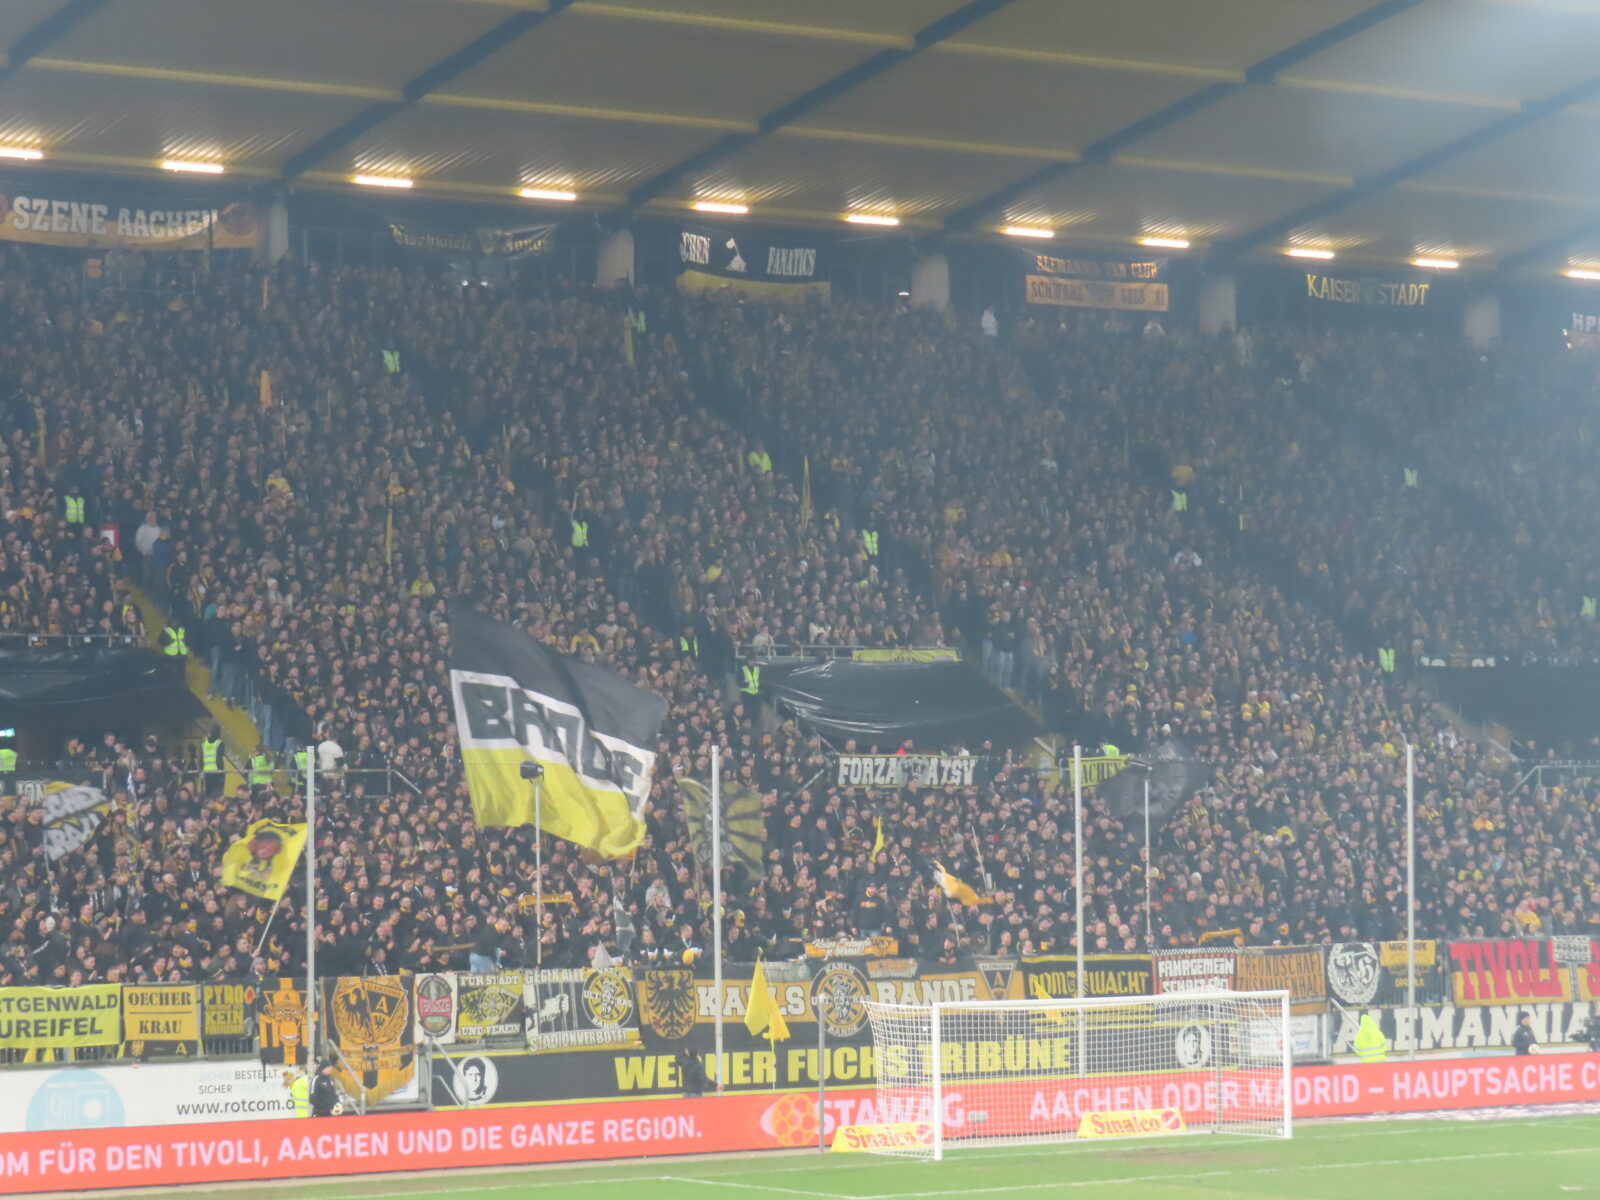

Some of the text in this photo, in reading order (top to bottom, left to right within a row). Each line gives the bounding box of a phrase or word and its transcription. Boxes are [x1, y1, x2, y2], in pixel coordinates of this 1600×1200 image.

[12, 196, 218, 238] SZENE AACHEN
[766, 246, 816, 276] FANATICS
[1031, 280, 1083, 302] SCHWARZ
[1306, 273, 1430, 307] KAISER STADT
[1571, 312, 1600, 334] HP
[838, 757, 976, 786] FORZA ATSV
[1157, 957, 1235, 978] FAHRGEMEIN
[1238, 951, 1322, 977] FREUNDSCHAFT
[1449, 940, 1563, 1000] TIVOLI
[486, 974, 519, 986] STADT
[524, 968, 560, 985] GEGEN
[1089, 970, 1150, 995] WACHT
[1238, 973, 1323, 999] ZUSAMMENHALT
[0, 994, 118, 1013] TGENWALD
[128, 992, 192, 1006] OECHER
[203, 985, 244, 1006] PYRO
[375, 996, 389, 1014] A
[697, 977, 976, 1017] KALS BANDE
[139, 1019, 182, 1034] KRAU
[205, 1009, 244, 1026] KEIN
[461, 1023, 521, 1037] UND VEREIN
[614, 1033, 1071, 1091] WENER FUCHS TRIBÜNE
[199, 1084, 233, 1095] SICHER
[1029, 1083, 1151, 1121] AACHEN
[1162, 1078, 1241, 1112] ODER
[1249, 1073, 1360, 1107] MADRID
[1392, 1063, 1573, 1100] HAUPTSACHE
[1581, 1062, 1600, 1090] C
[177, 1098, 296, 1115] www.rotcom.d
[817, 1093, 965, 1136] STAWAG
[1090, 1113, 1161, 1135] Sinalco
[39, 1142, 96, 1175] FÜR
[106, 1143, 162, 1171] DEN
[171, 1138, 269, 1168] TIVOLI,
[277, 1131, 388, 1161] AACHEN
[398, 1126, 453, 1155] UND
[461, 1125, 503, 1152] DIE
[510, 1120, 595, 1148] GANZE
[603, 1114, 703, 1144] REGION.
[844, 1126, 917, 1149] Sinalco
